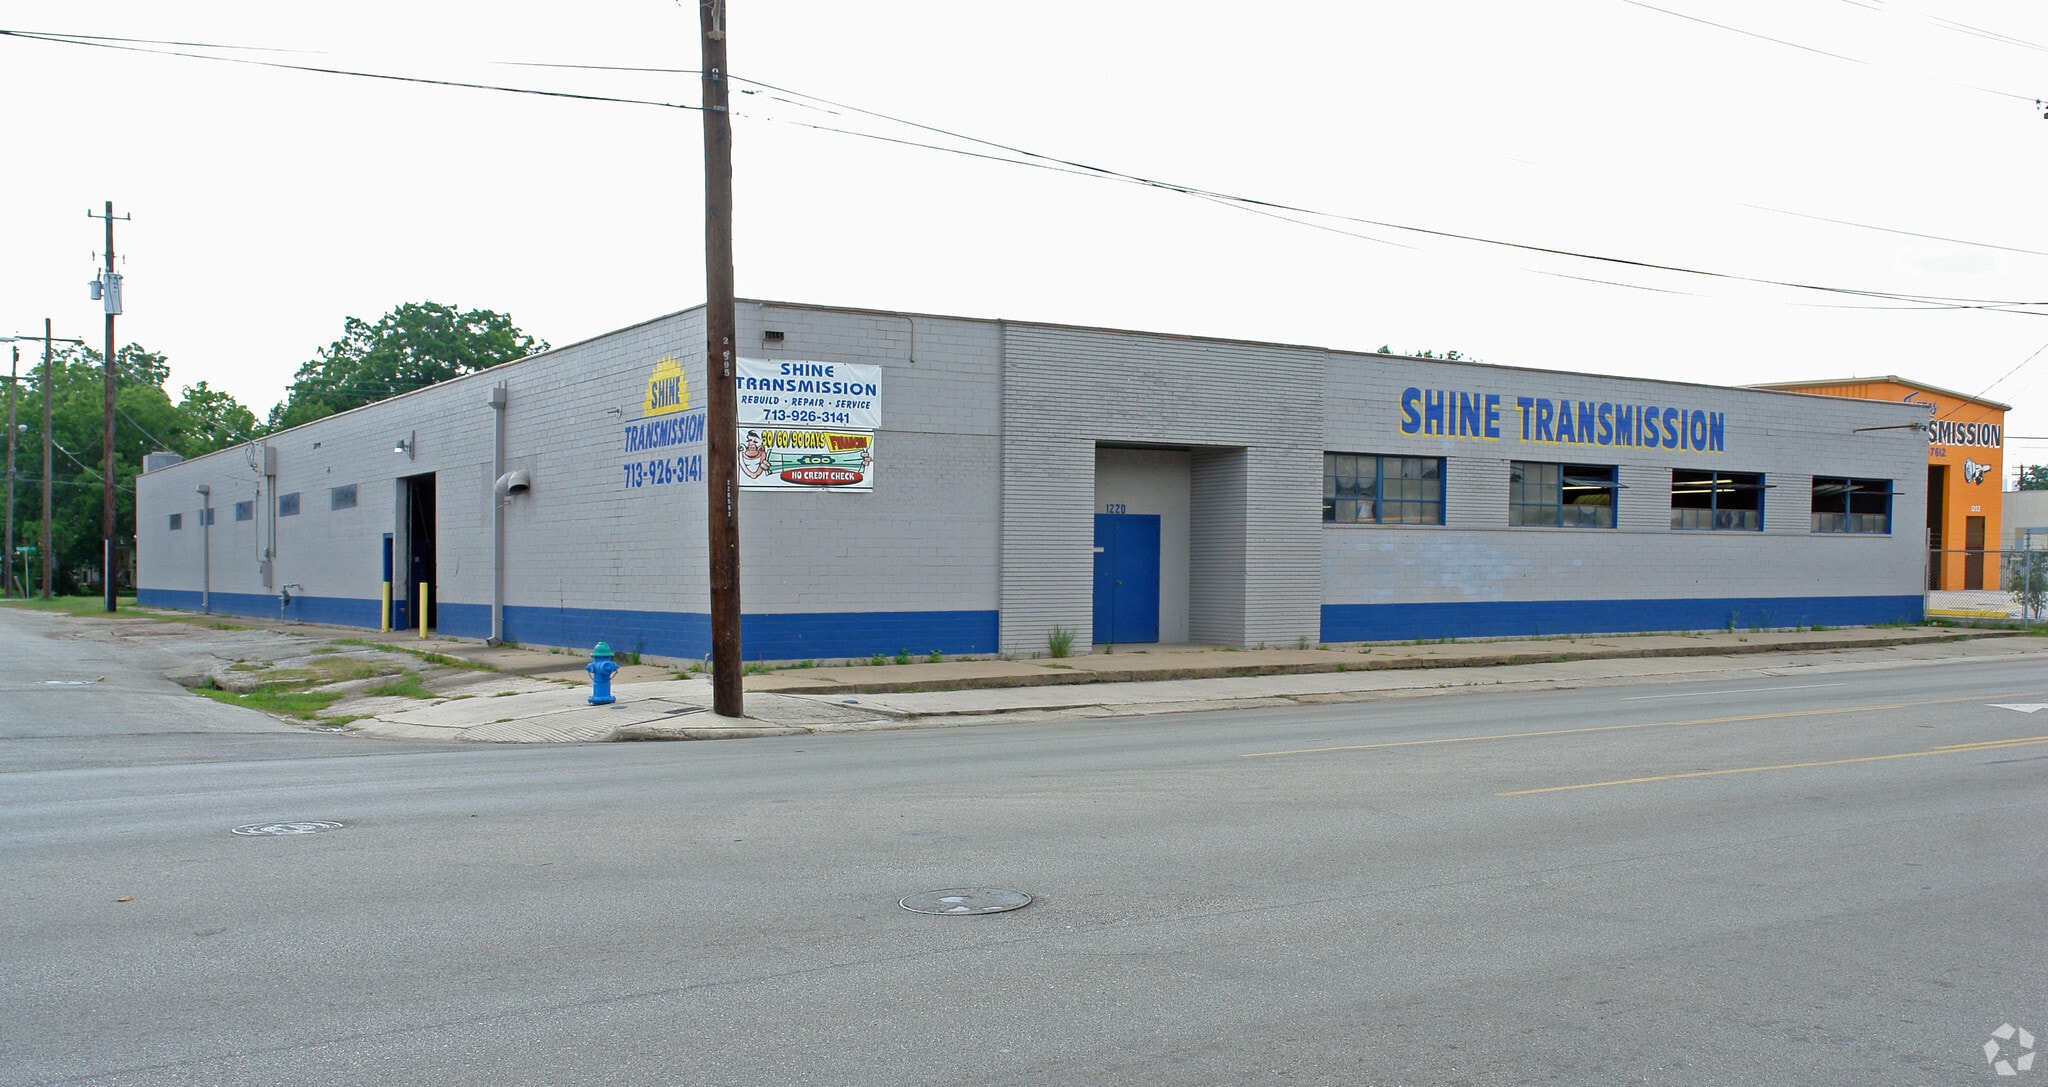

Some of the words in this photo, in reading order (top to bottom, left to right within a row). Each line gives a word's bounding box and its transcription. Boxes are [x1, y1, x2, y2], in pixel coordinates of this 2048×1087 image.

[780, 363, 834, 378] SHINE
[651, 376, 681, 409] SHINE
[736, 376, 877, 397] TRANSMISSION
[741, 395, 780, 405] REBUILD
[791, 398, 824, 408] REPAIR
[835, 400, 871, 410] SERVICE
[763, 409, 850, 424] 713-926-3141
[1400, 387, 1500, 439] SHINE
[1515, 396, 1725, 454] TRANSMISSION
[624, 413, 705, 452] TRANSMISSION
[762, 430, 803, 449] 30/60/90
[803, 432, 826, 449] DAYS
[623, 455, 702, 489] 713-926-3141
[791, 471, 803, 480] NO
[804, 471, 829, 481] CREDIT
[831, 472, 855, 481] CHECK
[1106, 503, 1126, 514] 1220
